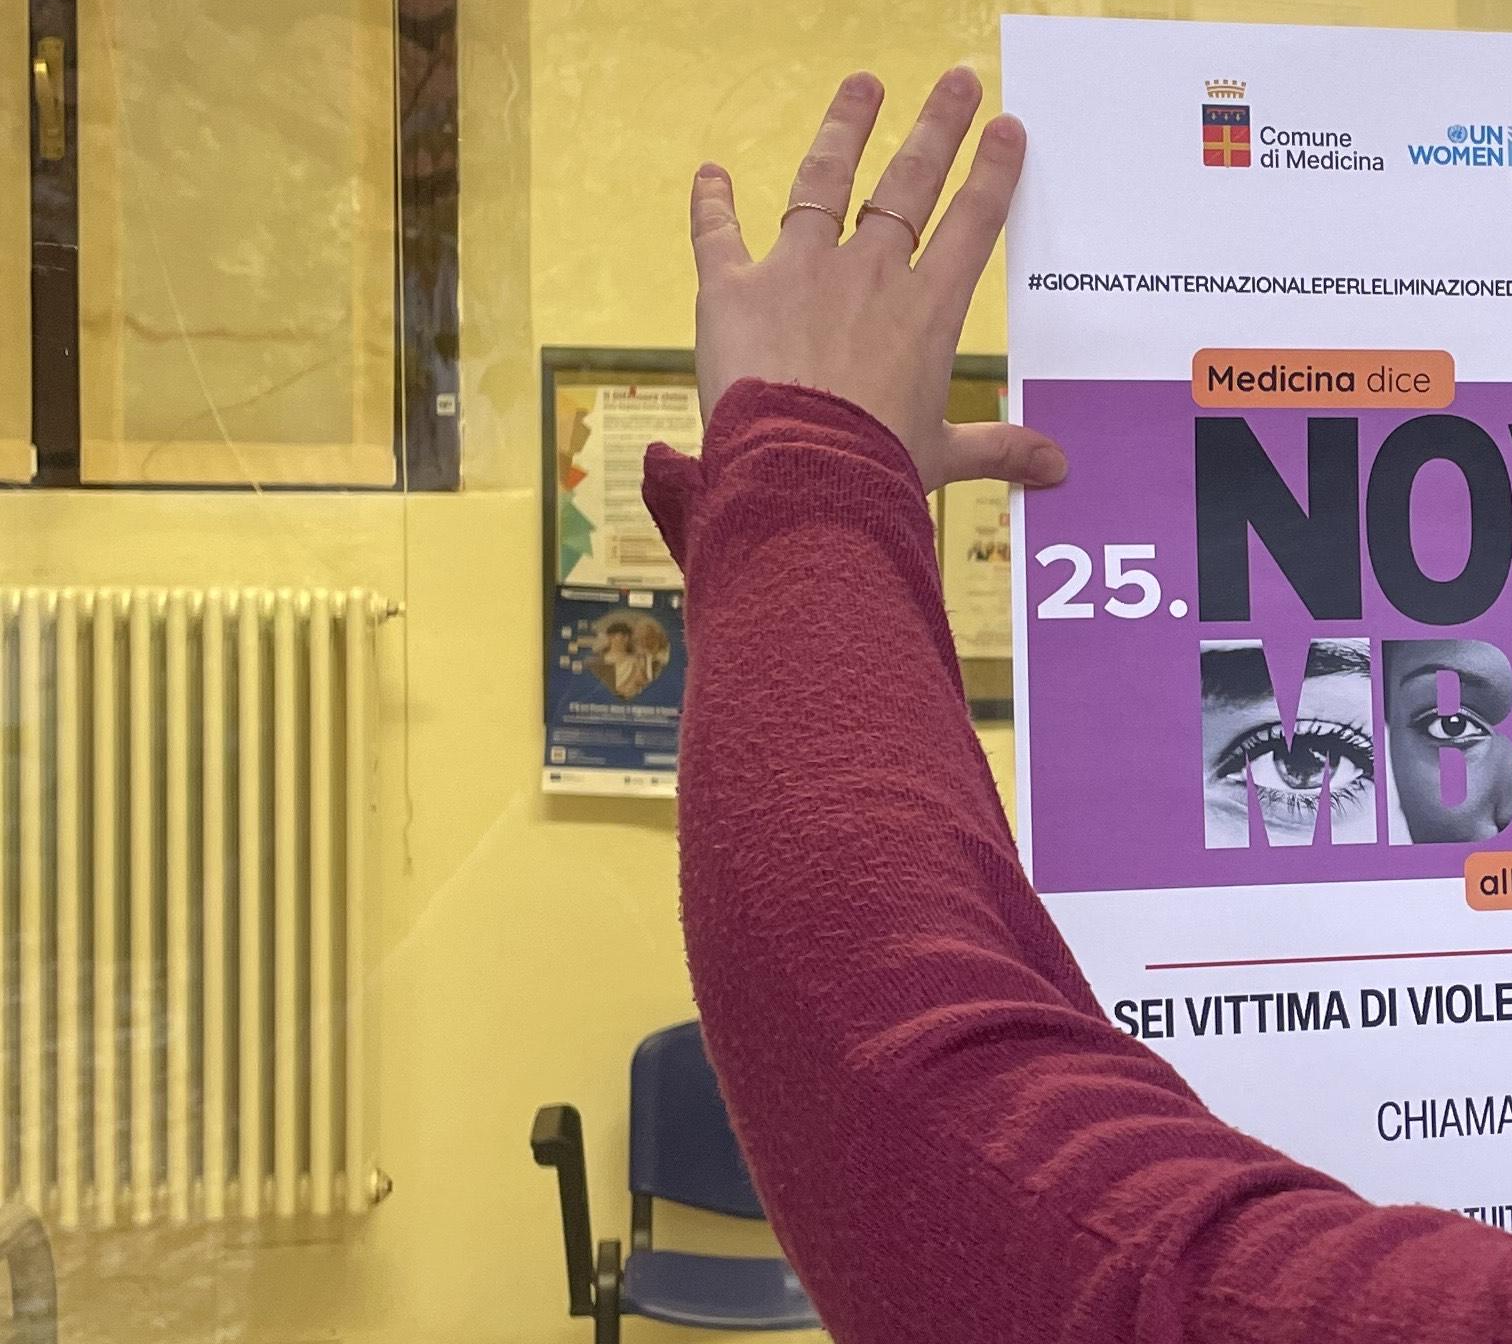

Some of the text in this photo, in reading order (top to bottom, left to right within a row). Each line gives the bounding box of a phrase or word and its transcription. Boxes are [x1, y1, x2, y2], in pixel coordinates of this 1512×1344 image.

[1259, 126, 1352, 147] Comune
[1470, 125, 1503, 145] UN
[1260, 149, 1385, 171] di Medicina
[1408, 145, 1504, 167] WOMEN
[1207, 365, 1431, 393] Medicina dice
[1034, 543, 1188, 620] 25.
[1114, 998, 1175, 1039] SEI
[1185, 990, 1351, 1037] VITTIMA
[1360, 987, 1398, 1028] DI
